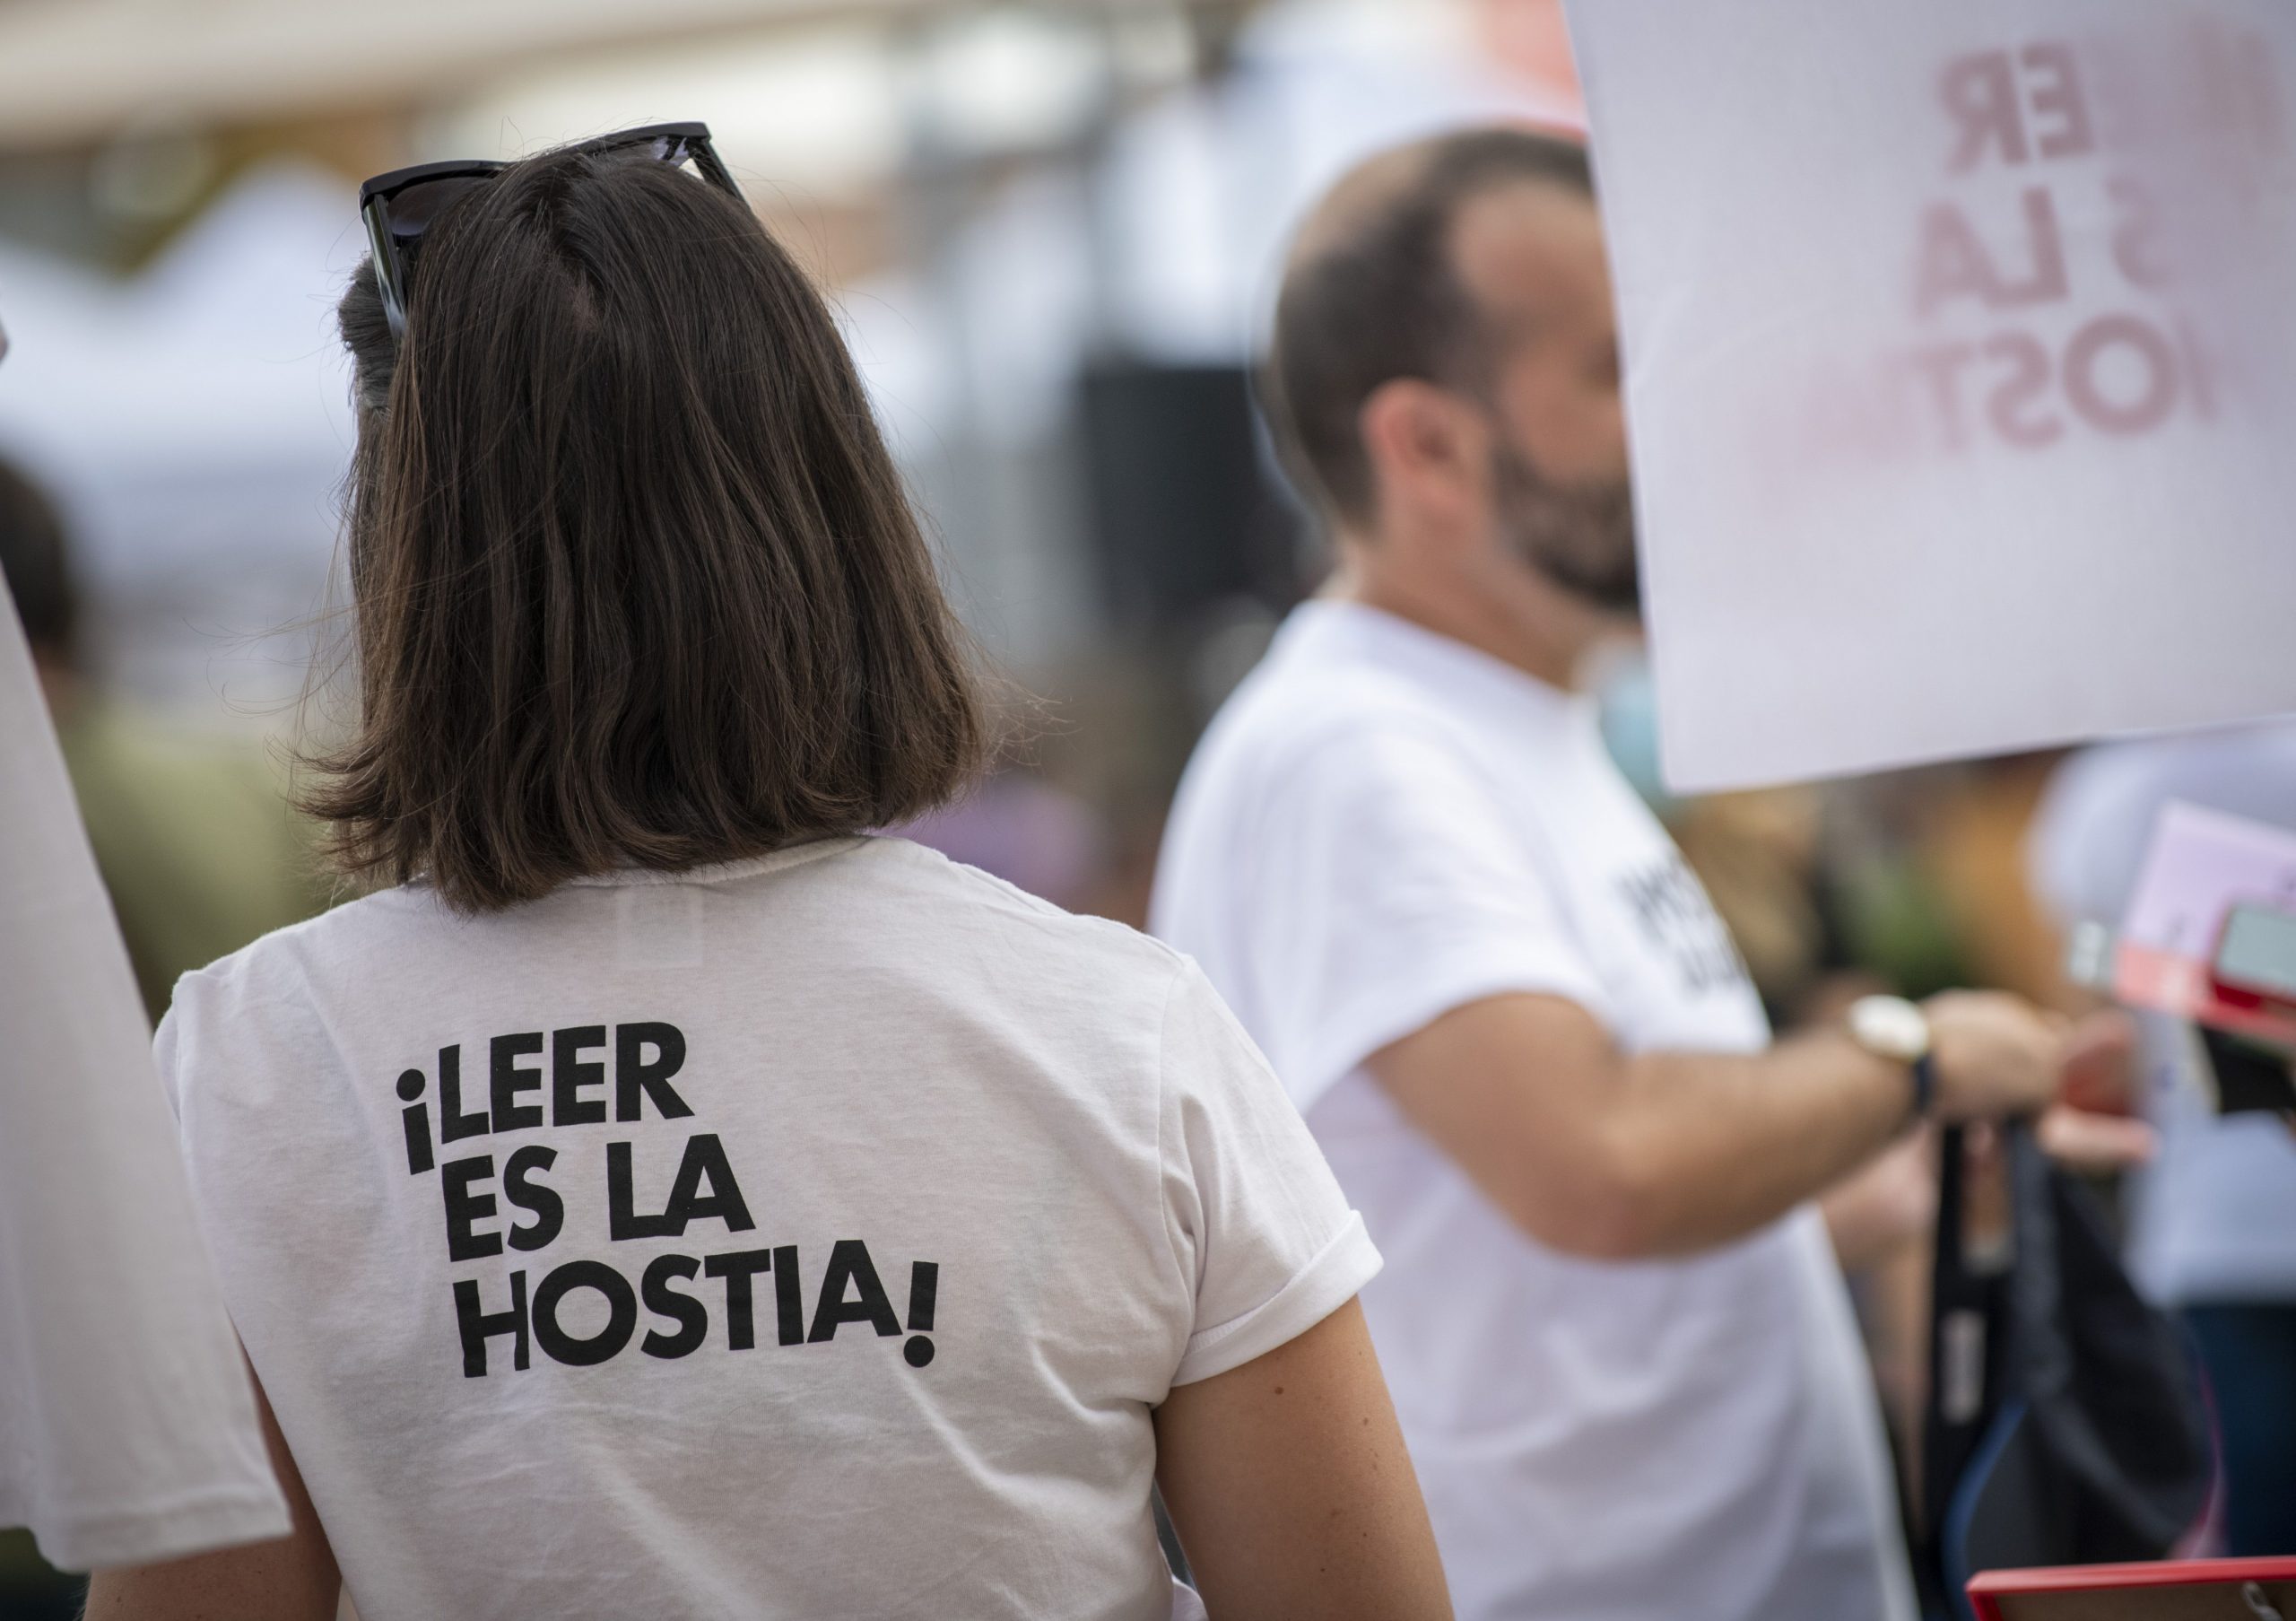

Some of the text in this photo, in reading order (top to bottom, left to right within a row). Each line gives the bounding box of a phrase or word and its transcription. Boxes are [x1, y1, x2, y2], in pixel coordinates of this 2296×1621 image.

[396, 1021, 695, 1176] ¡LEER
[440, 1133, 756, 1262] ES LA
[452, 1239, 939, 1379] HOSTIA!
